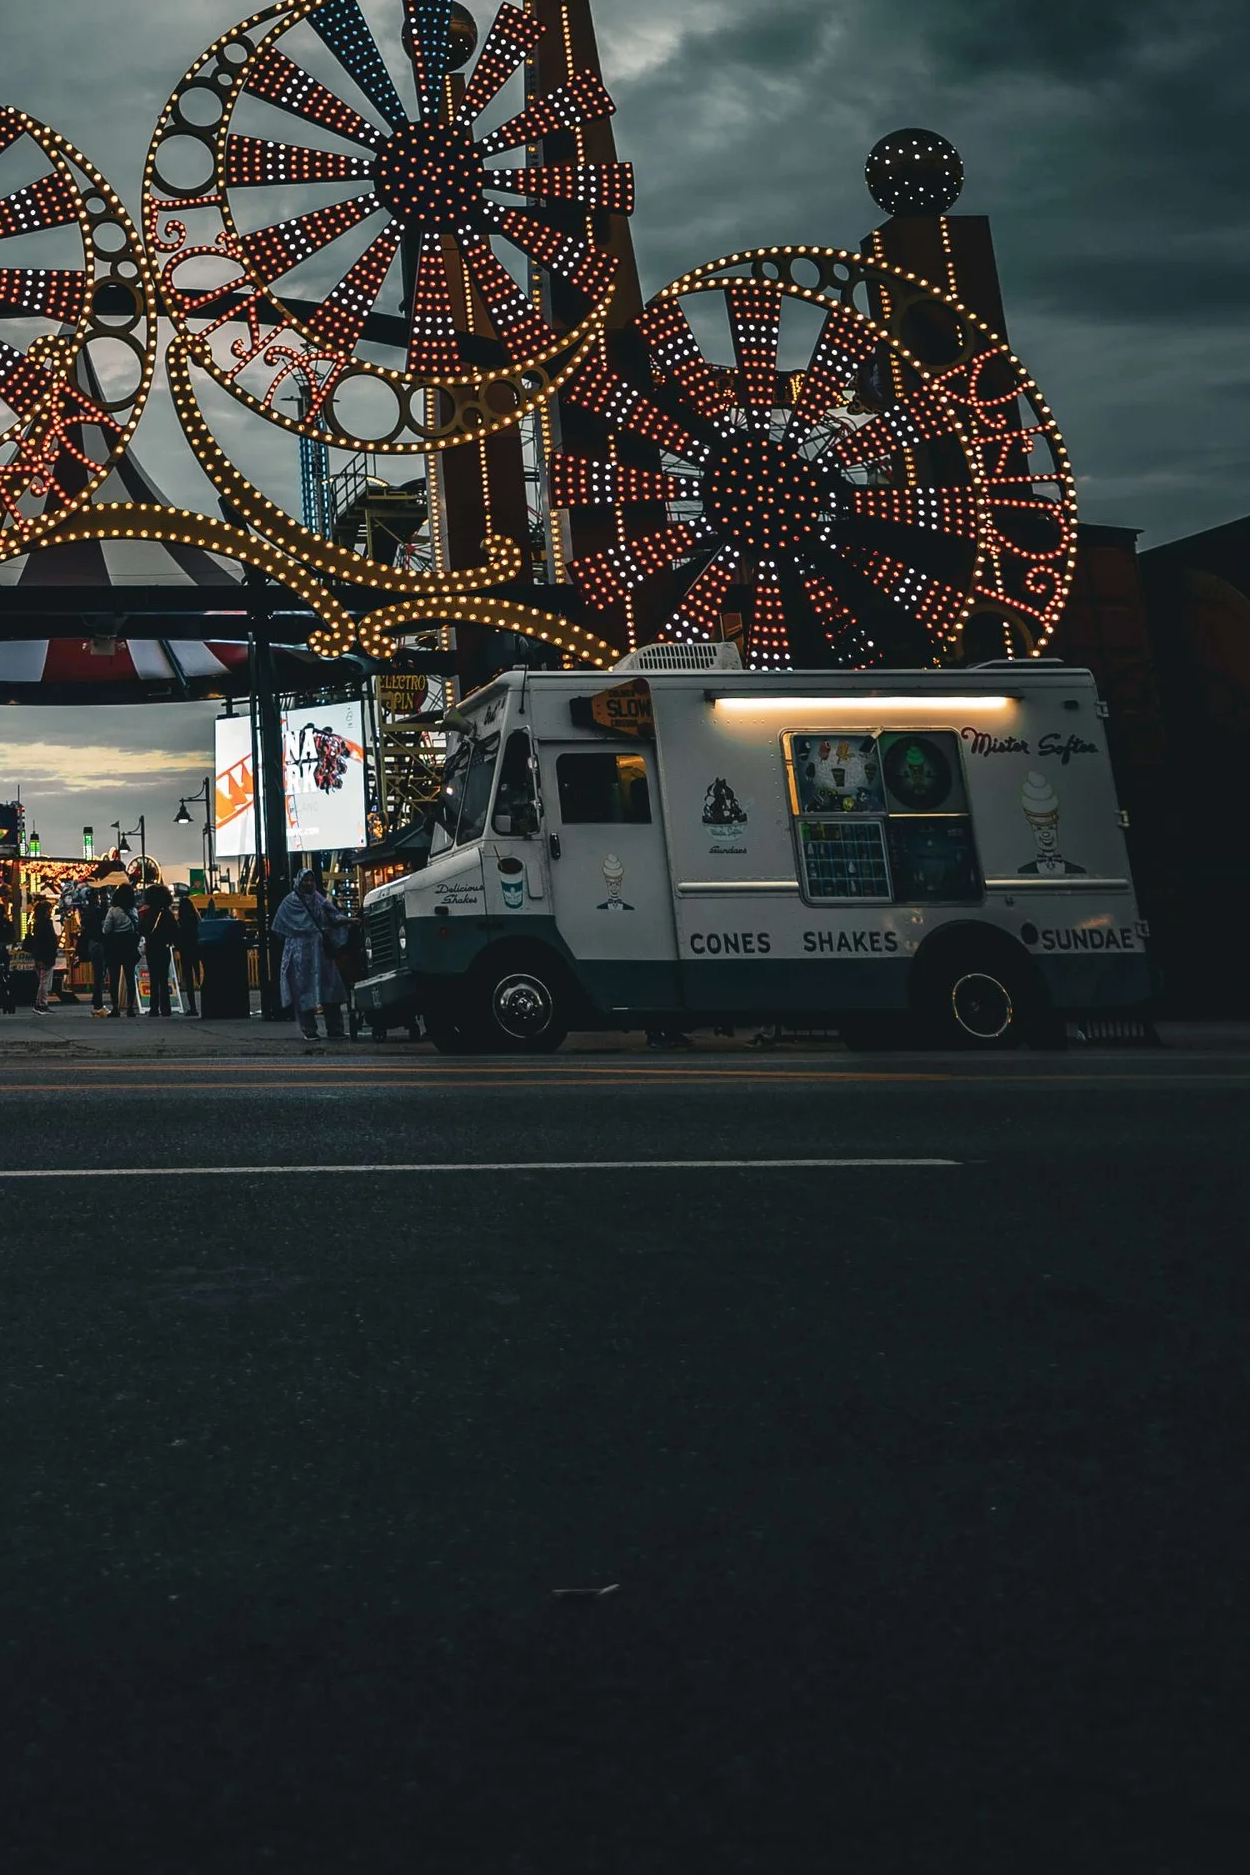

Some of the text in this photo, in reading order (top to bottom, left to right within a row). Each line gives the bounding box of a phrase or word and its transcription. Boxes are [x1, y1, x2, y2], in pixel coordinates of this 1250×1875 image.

[606, 699, 652, 718] SLOW
[961, 727, 1099, 765] Mister Softee
[435, 883, 485, 895] Delicious
[440, 894, 478, 905] Shakes
[689, 928, 1135, 955] CONES SHAKES SUNDAE
